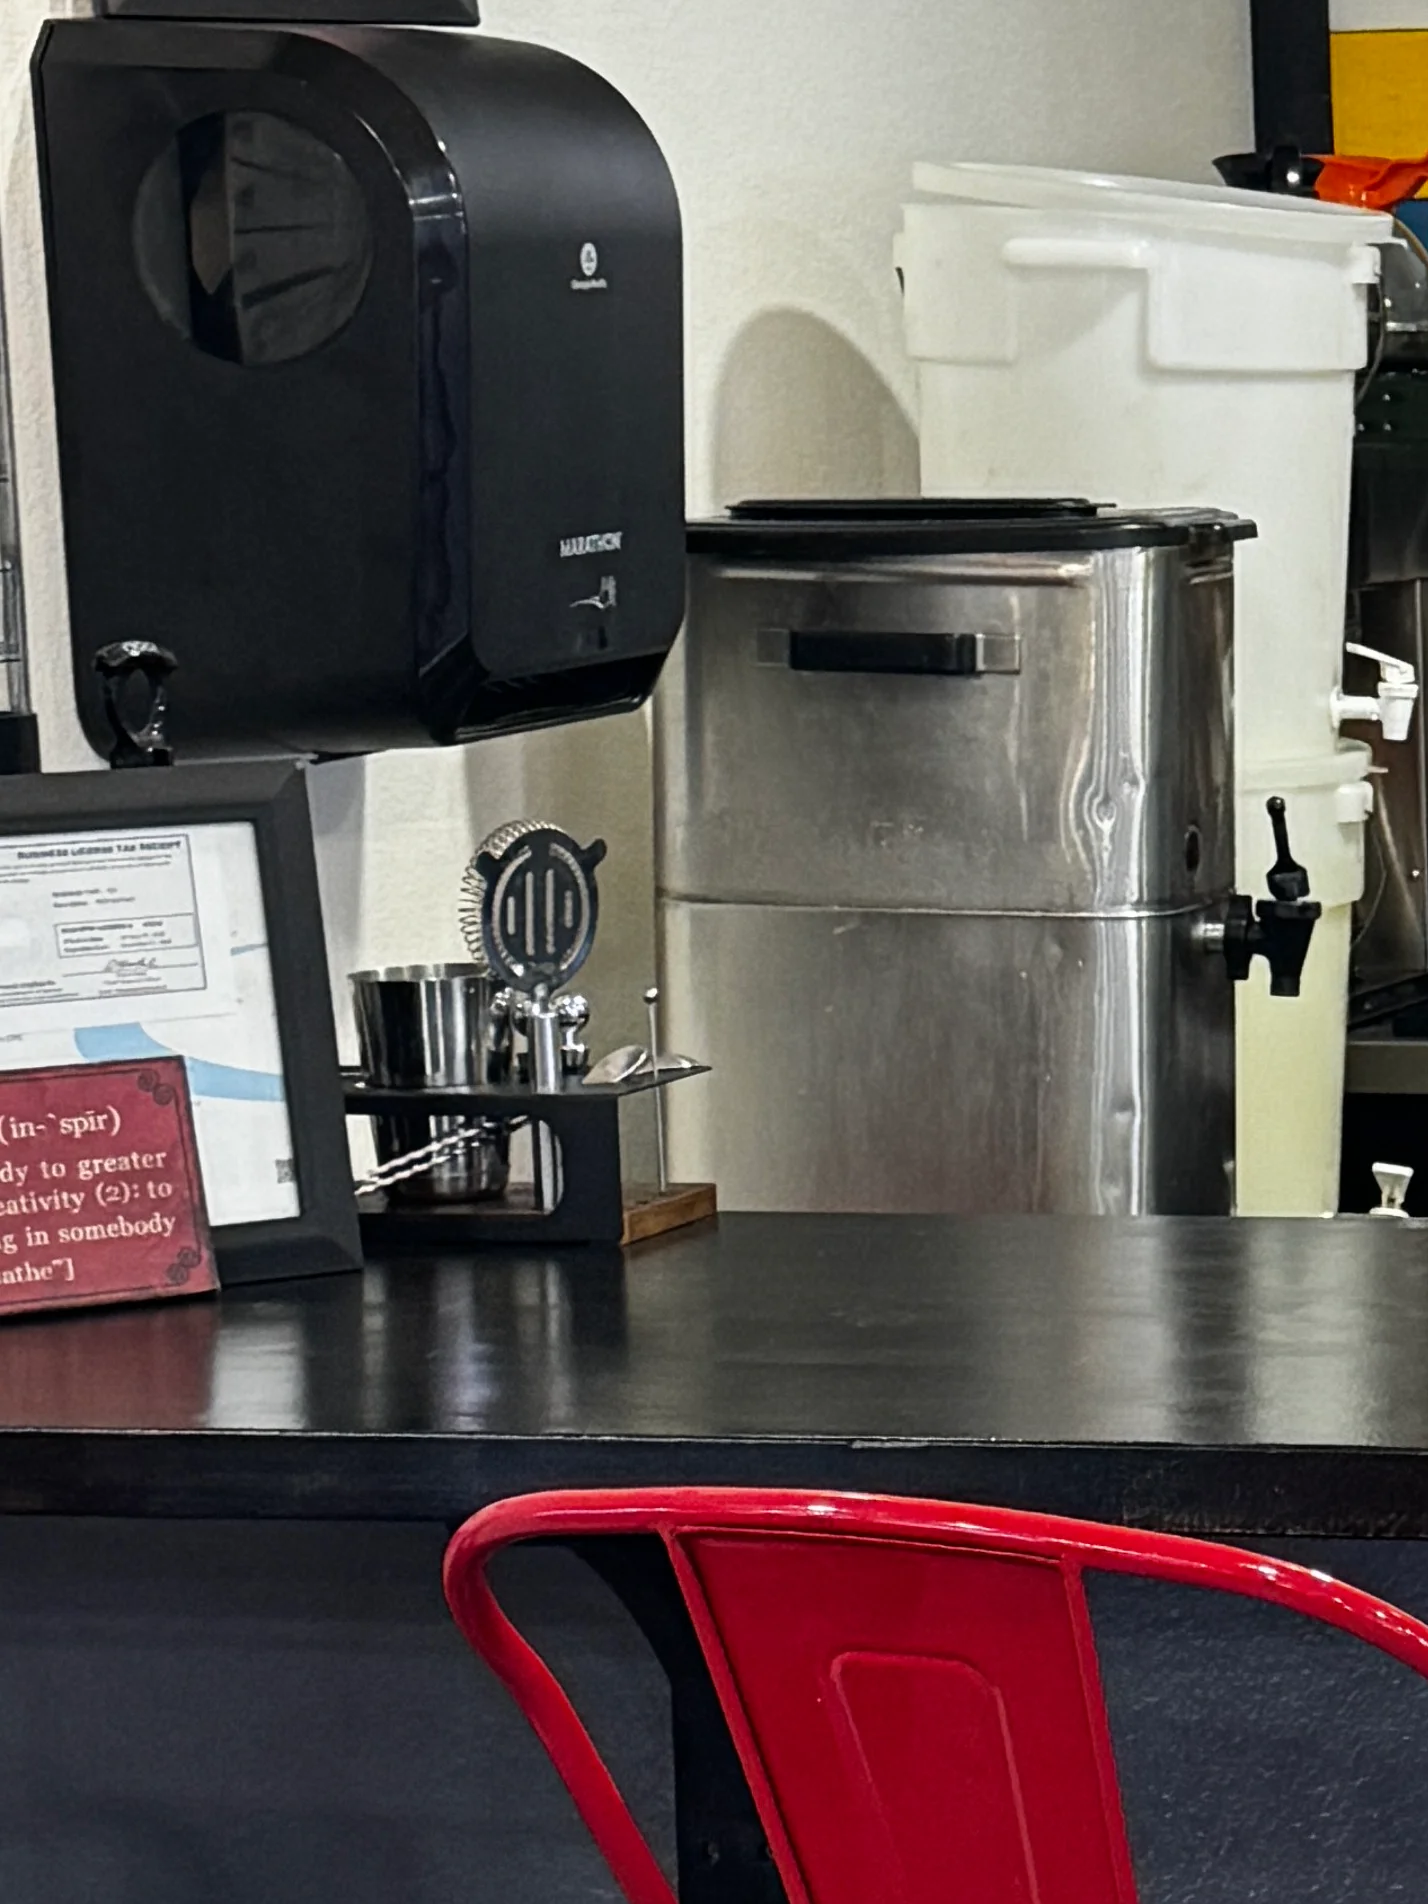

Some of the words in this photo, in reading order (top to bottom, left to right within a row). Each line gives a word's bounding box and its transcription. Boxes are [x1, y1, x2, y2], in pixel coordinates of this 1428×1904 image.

[40, 1161, 66, 1179] to
[78, 1152, 167, 1181] greater
[147, 1180, 173, 1198] to
[25, 1226, 50, 1247] in
[58, 1211, 176, 1244] somebody
